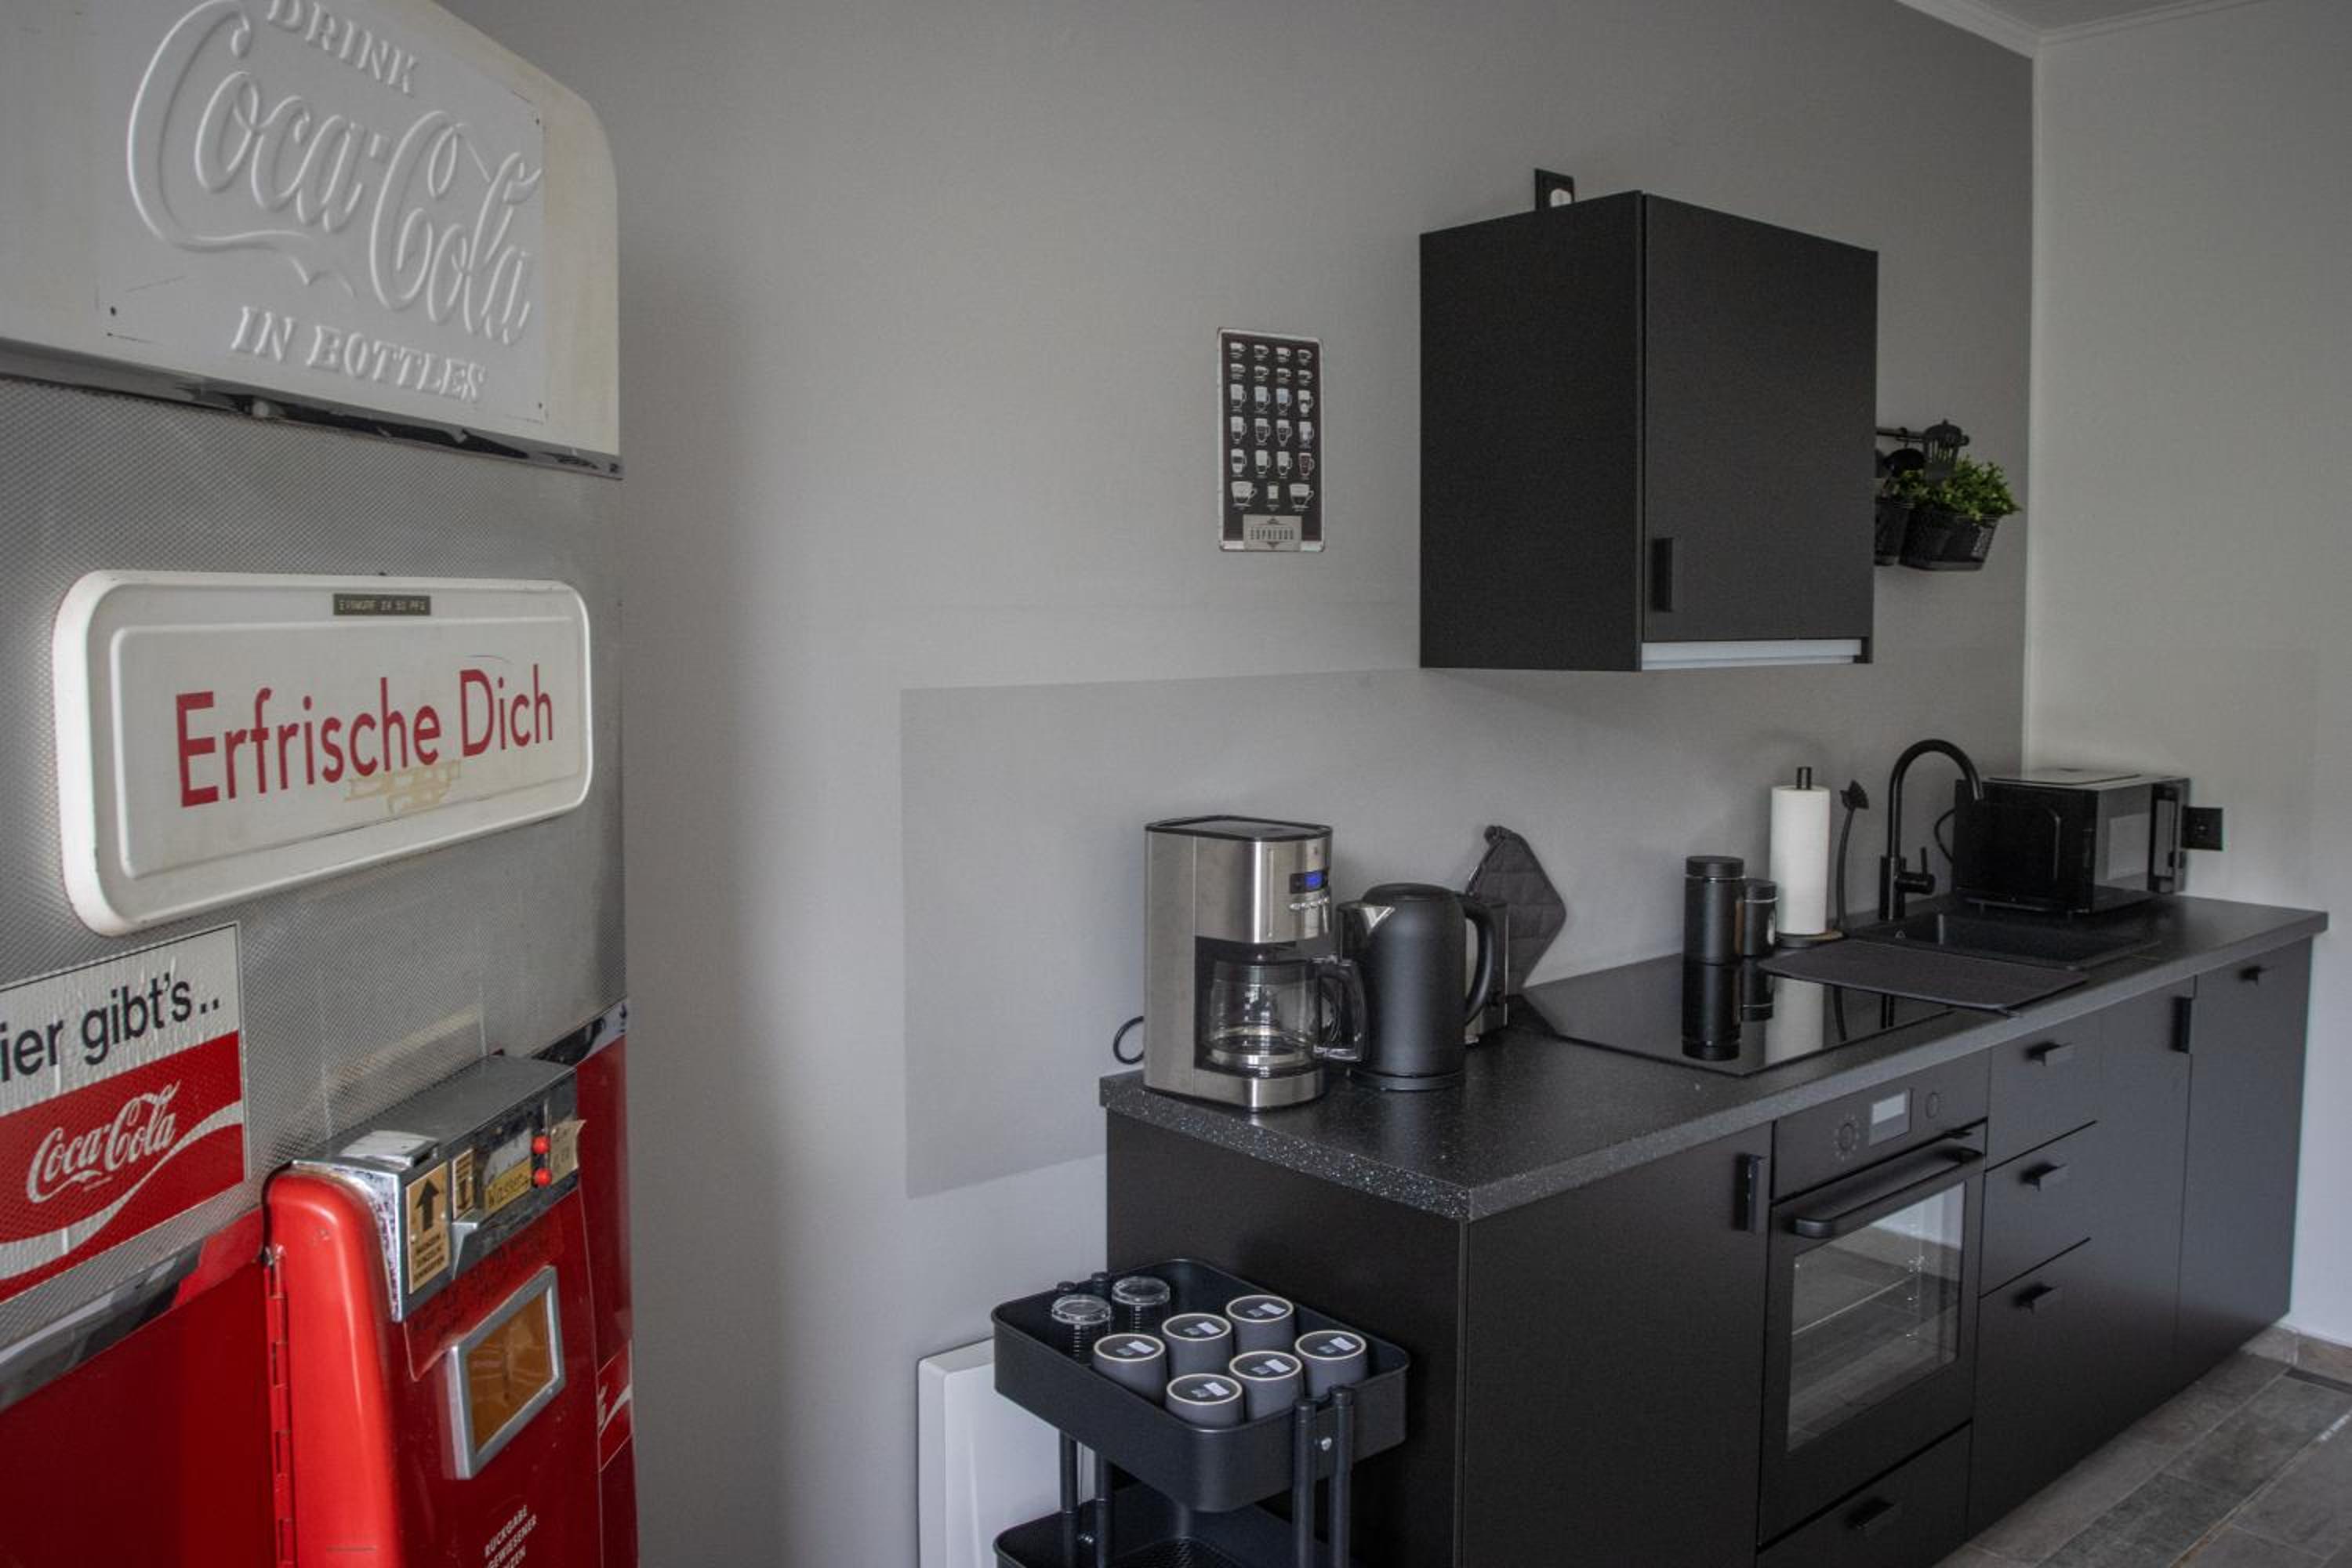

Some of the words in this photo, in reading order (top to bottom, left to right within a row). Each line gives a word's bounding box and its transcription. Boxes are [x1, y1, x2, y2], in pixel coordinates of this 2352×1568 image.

[265, 0, 420, 96] DRINK
[126, 0, 543, 346] Coca-Cola
[230, 306, 295, 362] IN
[306, 324, 488, 403] BOTTLES
[175, 677, 442, 808] Erfrische
[459, 664, 554, 757] Dich
[26, 1080, 181, 1204] Coca-Cola
